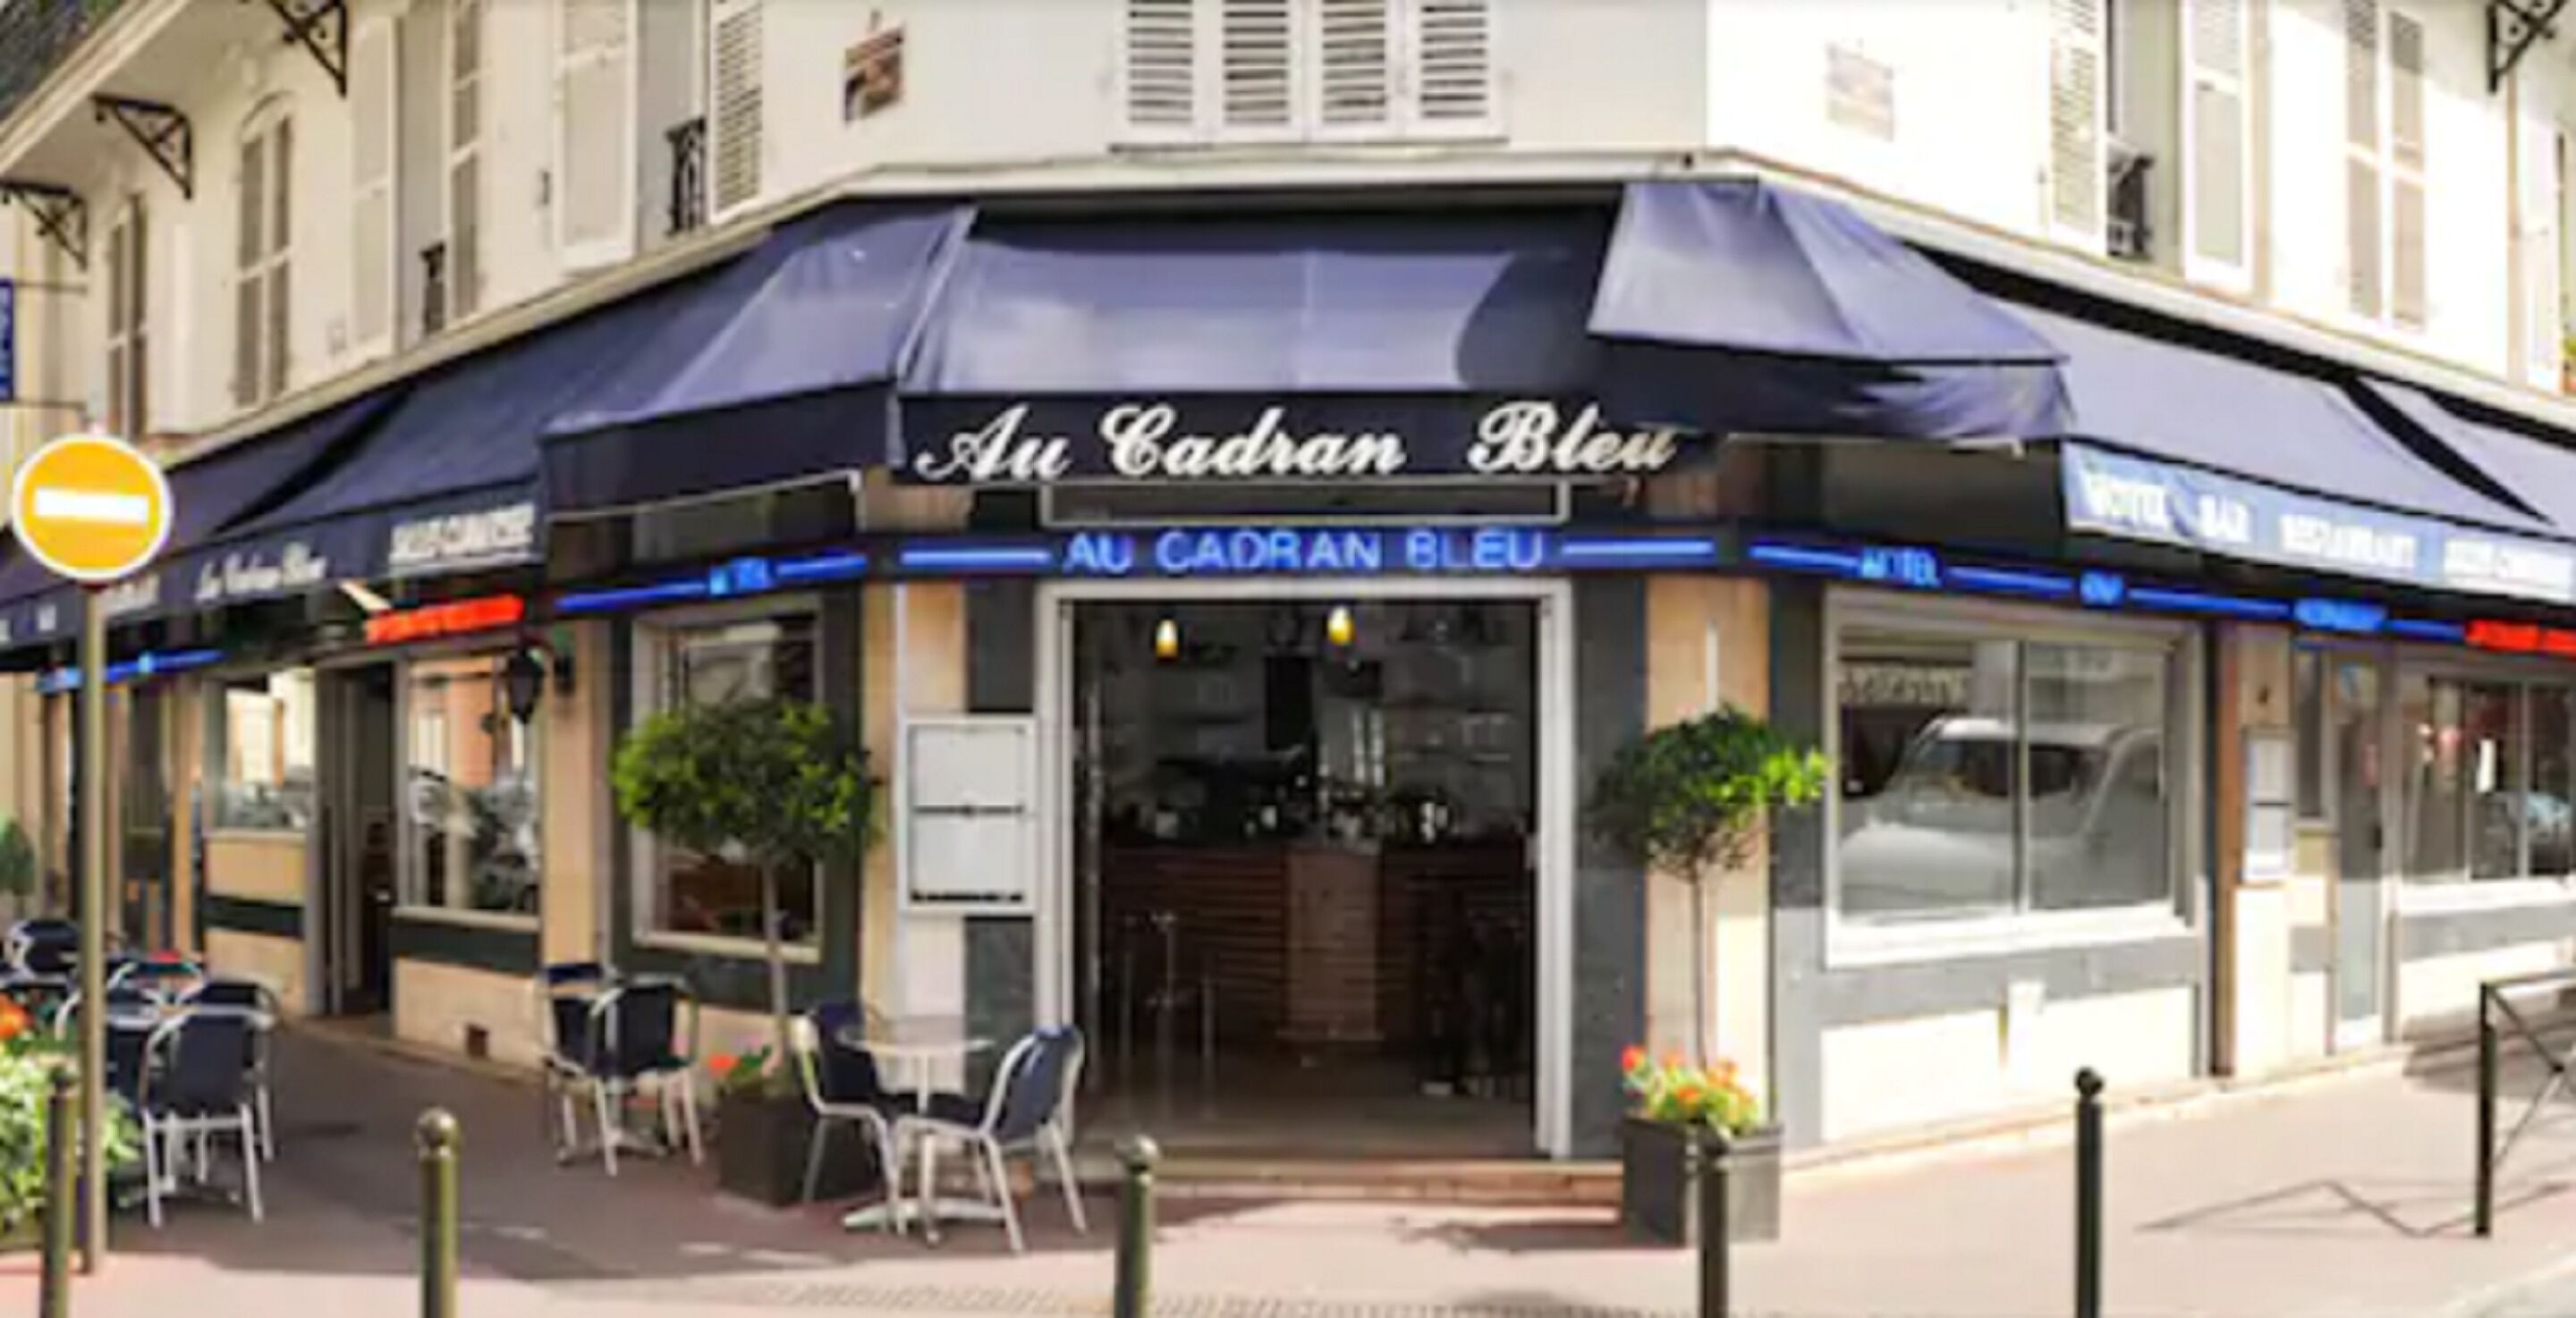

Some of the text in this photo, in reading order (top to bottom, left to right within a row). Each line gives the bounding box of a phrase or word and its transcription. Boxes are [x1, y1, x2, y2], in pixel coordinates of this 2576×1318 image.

[914, 401, 1678, 481] Au Cadran Bleu
[1065, 529, 1544, 572] AU CADRAN BLEU
